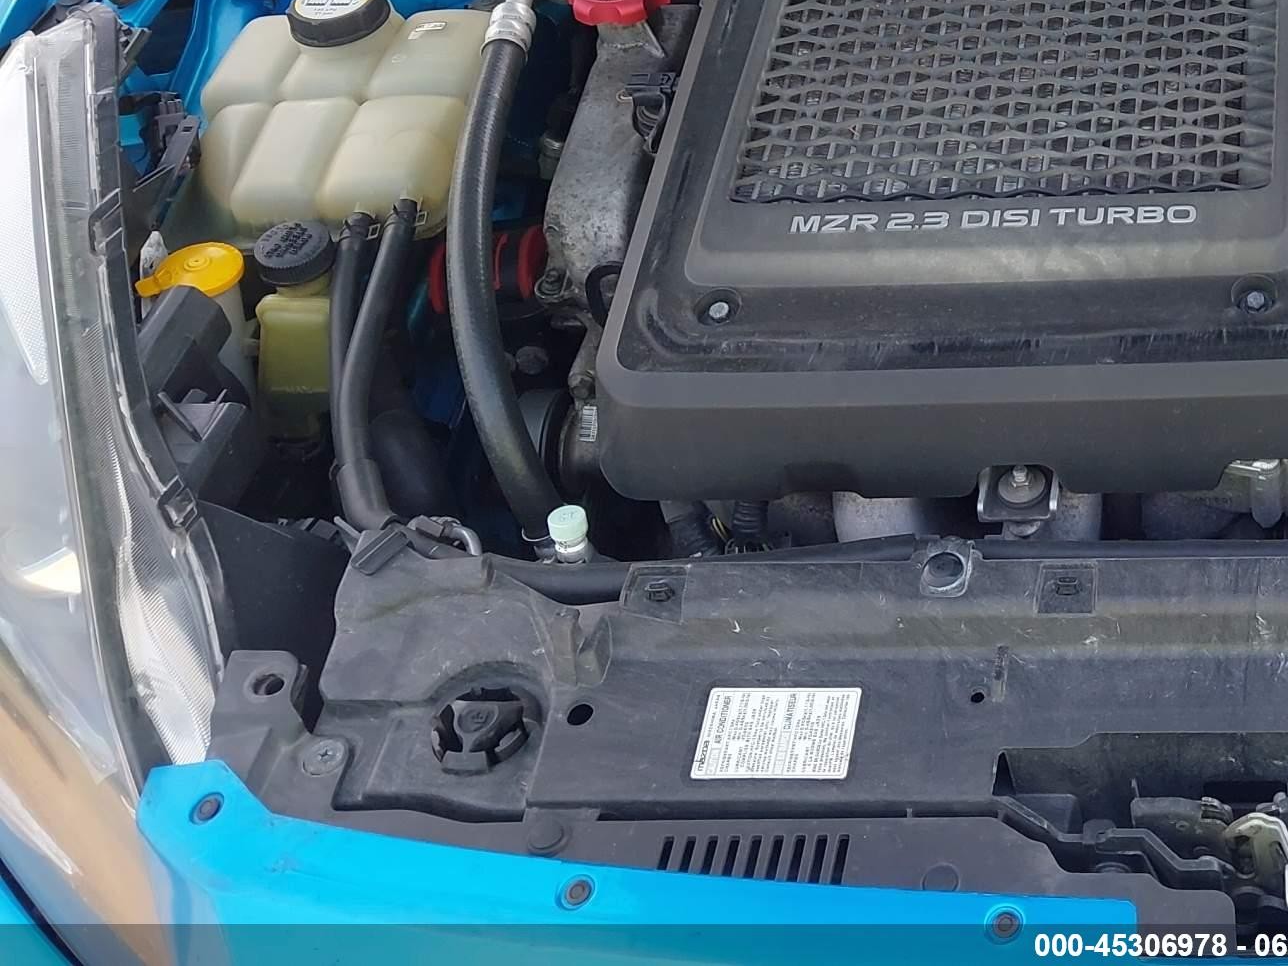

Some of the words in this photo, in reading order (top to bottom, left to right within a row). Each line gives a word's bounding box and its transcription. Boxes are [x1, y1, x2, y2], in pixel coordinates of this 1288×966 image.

[789, 214, 878, 234] MZR
[885, 212, 949, 234] 2.3
[960, 209, 1041, 229] DISI
[1049, 206, 1197, 227] TURBO
